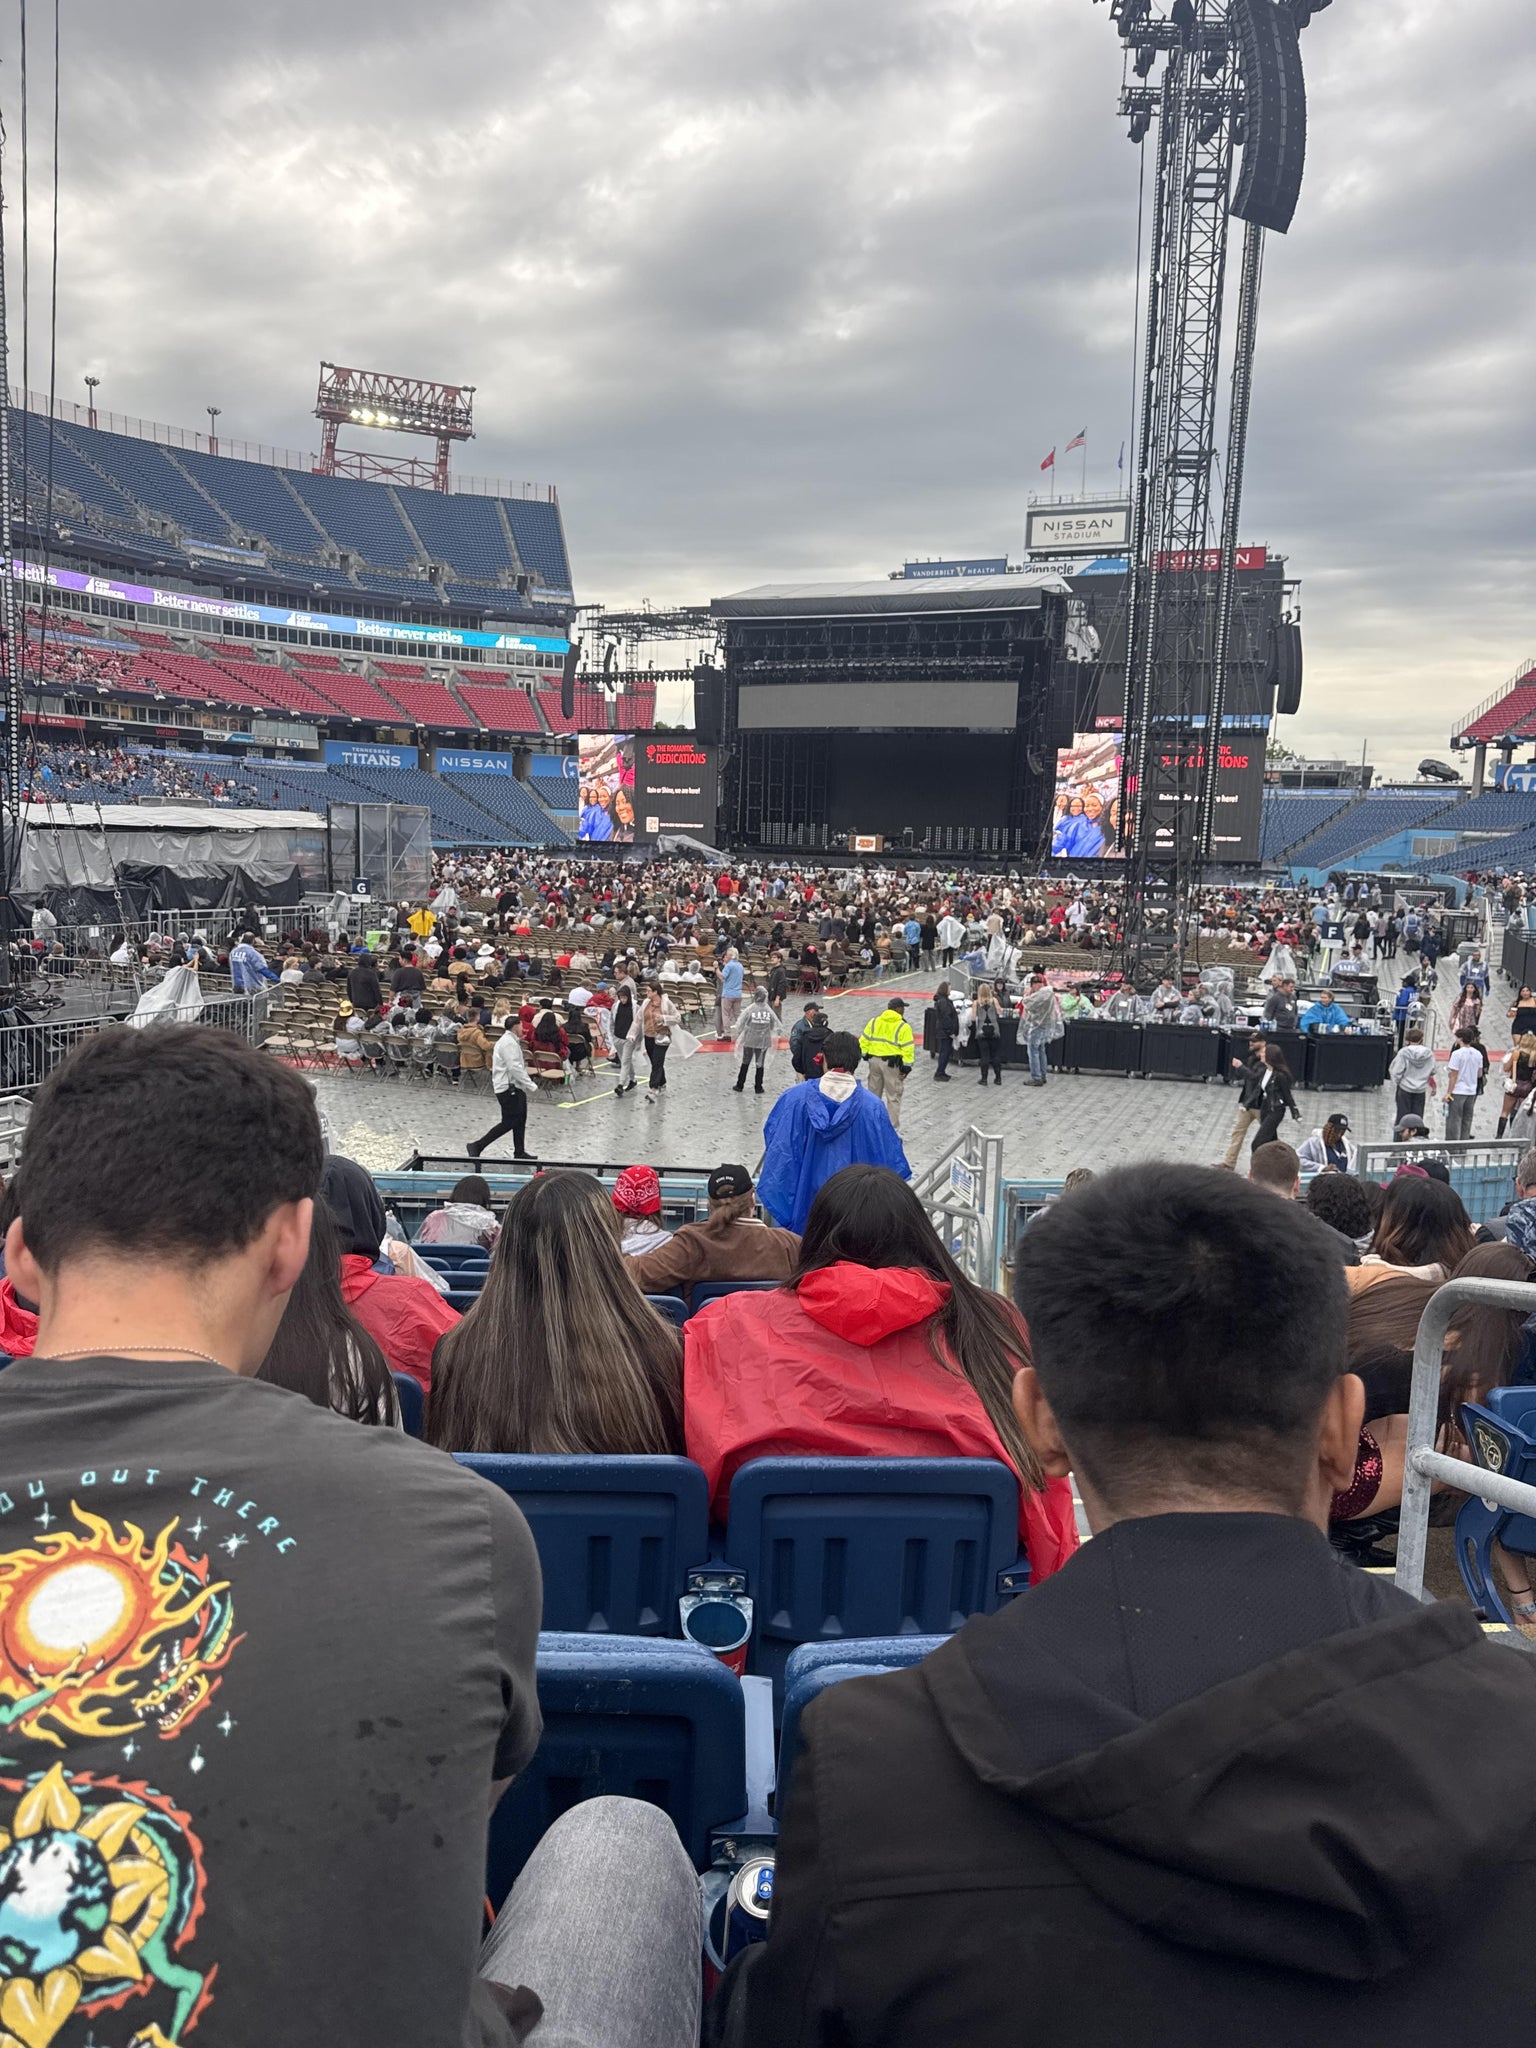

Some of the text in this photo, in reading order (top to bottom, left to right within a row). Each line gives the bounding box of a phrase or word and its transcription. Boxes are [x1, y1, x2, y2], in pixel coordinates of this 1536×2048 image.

[1043, 518, 1113, 532] NISSAN
[1053, 531, 1101, 541] STADIUM
[912, 568, 955, 577] VANDERBILT
[967, 567, 995, 575] HEALTH
[152, 590, 260, 621] Better never settles
[356, 620, 463, 645] Better never settles
[656, 744, 694, 753] THE ROMANTIC
[341, 751, 402, 767] TITANS
[441, 756, 508, 770] NISSAN
[655, 753, 706, 764] DEDICATIONS
[356, 883, 367, 894] G
[1327, 926, 1338, 938] F
[81, 1469, 160, 1486] OUT
[190, 1476, 297, 1554] THERE
